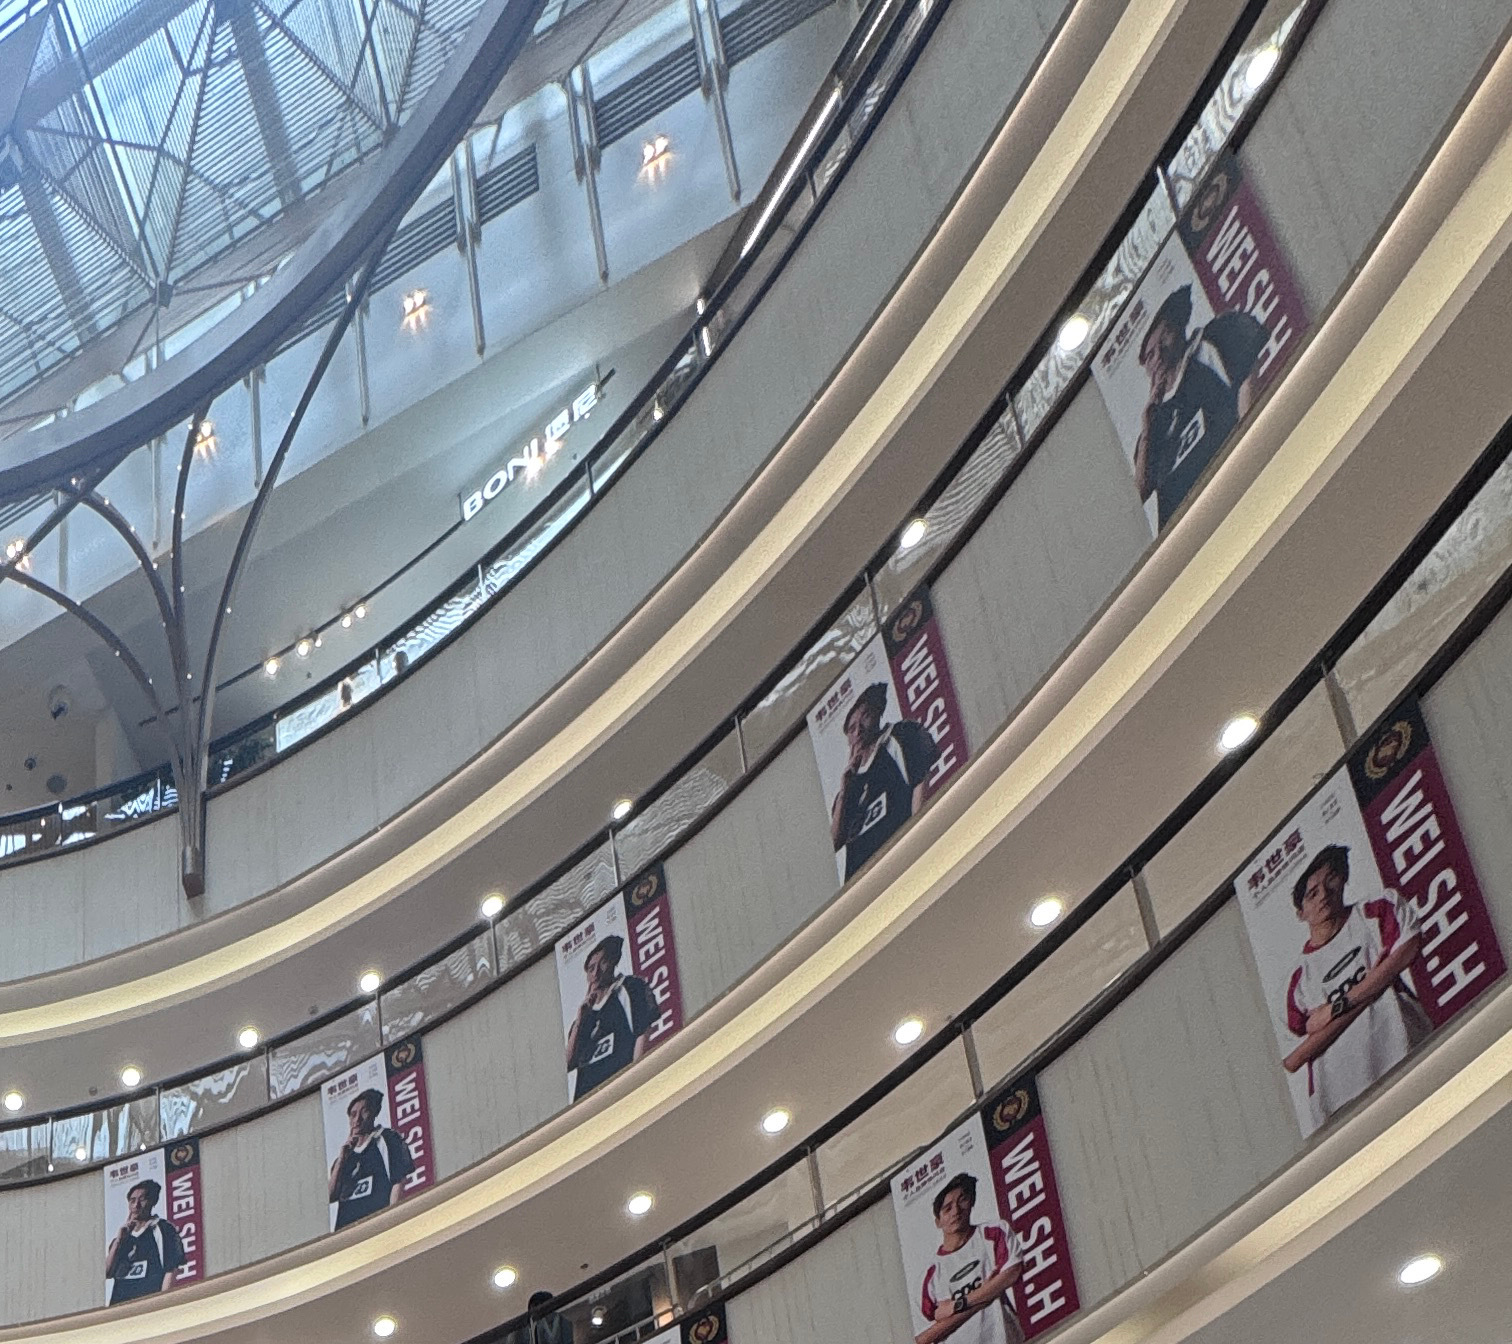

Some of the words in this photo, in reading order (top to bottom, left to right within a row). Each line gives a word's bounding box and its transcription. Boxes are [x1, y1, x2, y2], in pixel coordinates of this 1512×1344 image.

[1206, 205, 1259, 301] WEI
[902, 633, 939, 712] WEI
[1380, 769, 1445, 886] WEI
[636, 906, 665, 970] WEI
[395, 1072, 420, 1126] WEI
[172, 1172, 195, 1220] WEI
[1001, 1132, 1046, 1220] WEI
